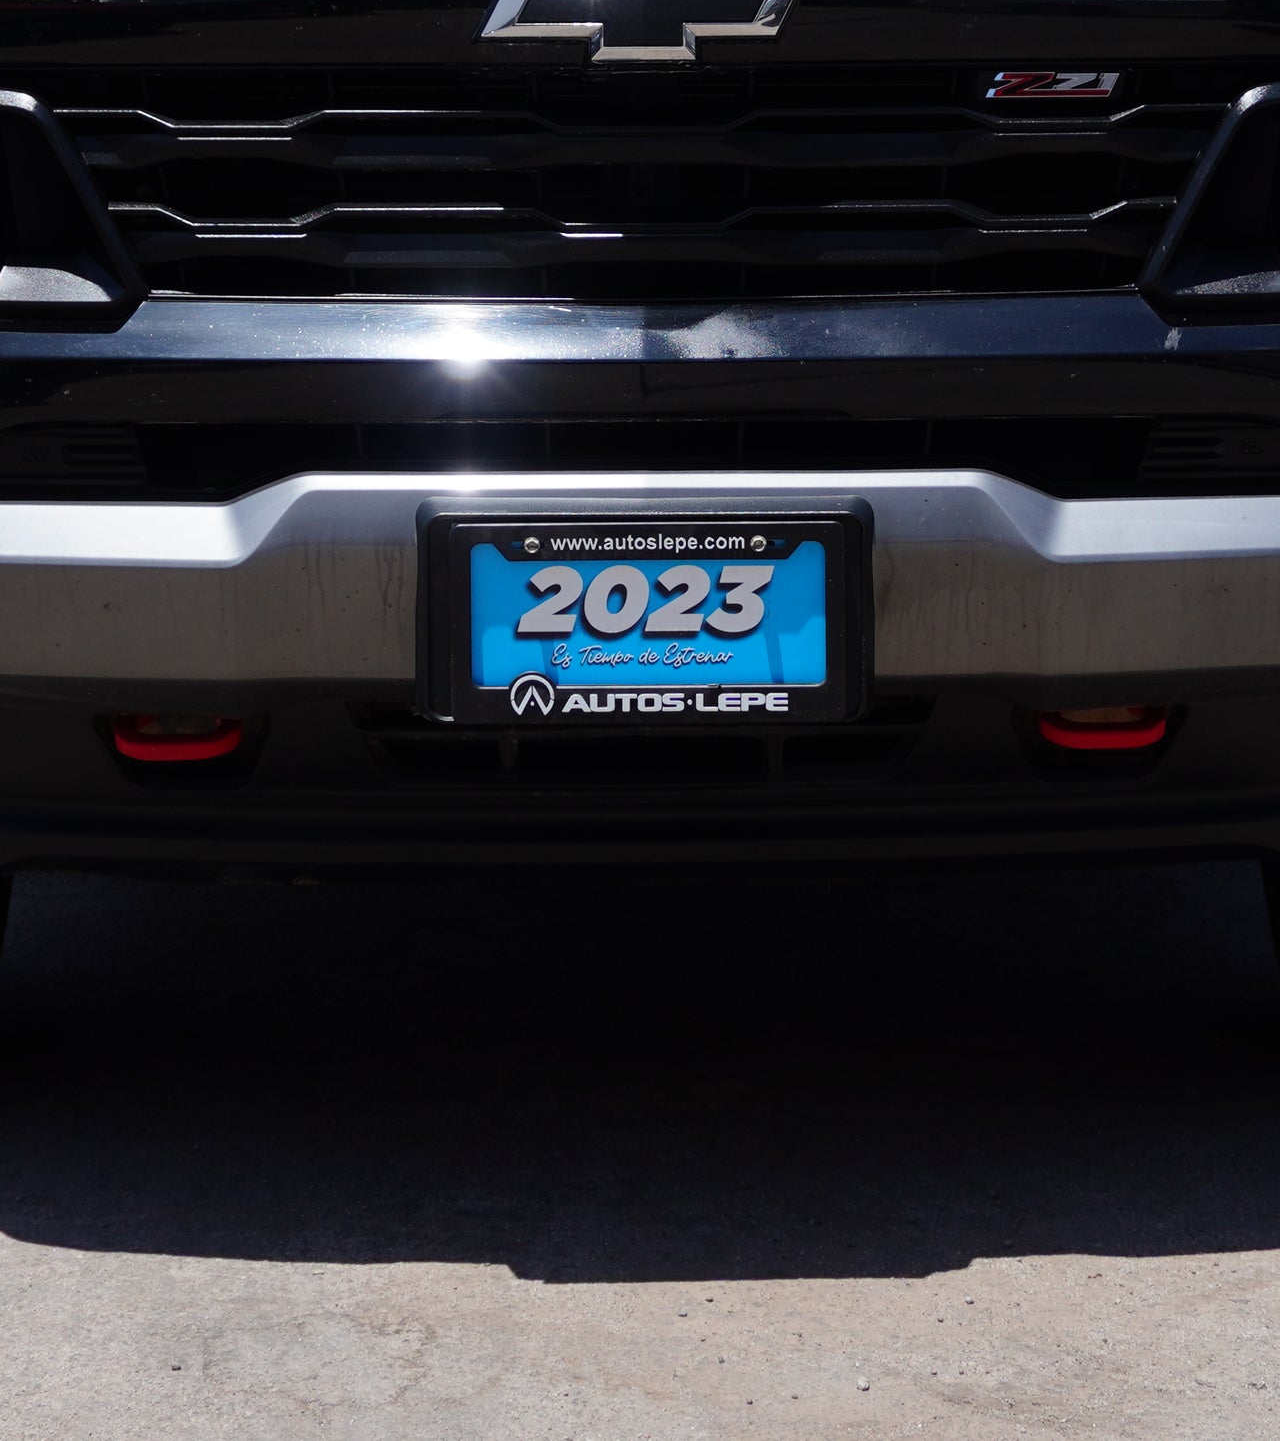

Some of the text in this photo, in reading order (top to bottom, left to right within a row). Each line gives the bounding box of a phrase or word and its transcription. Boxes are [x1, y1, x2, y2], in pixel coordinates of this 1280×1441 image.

[985, 71, 1120, 98] Z71
[550, 533, 746, 554] www.autoslepe.com
[517, 564, 776, 634] 2023
[551, 641, 735, 669] Es Tiempo de Estrenar
